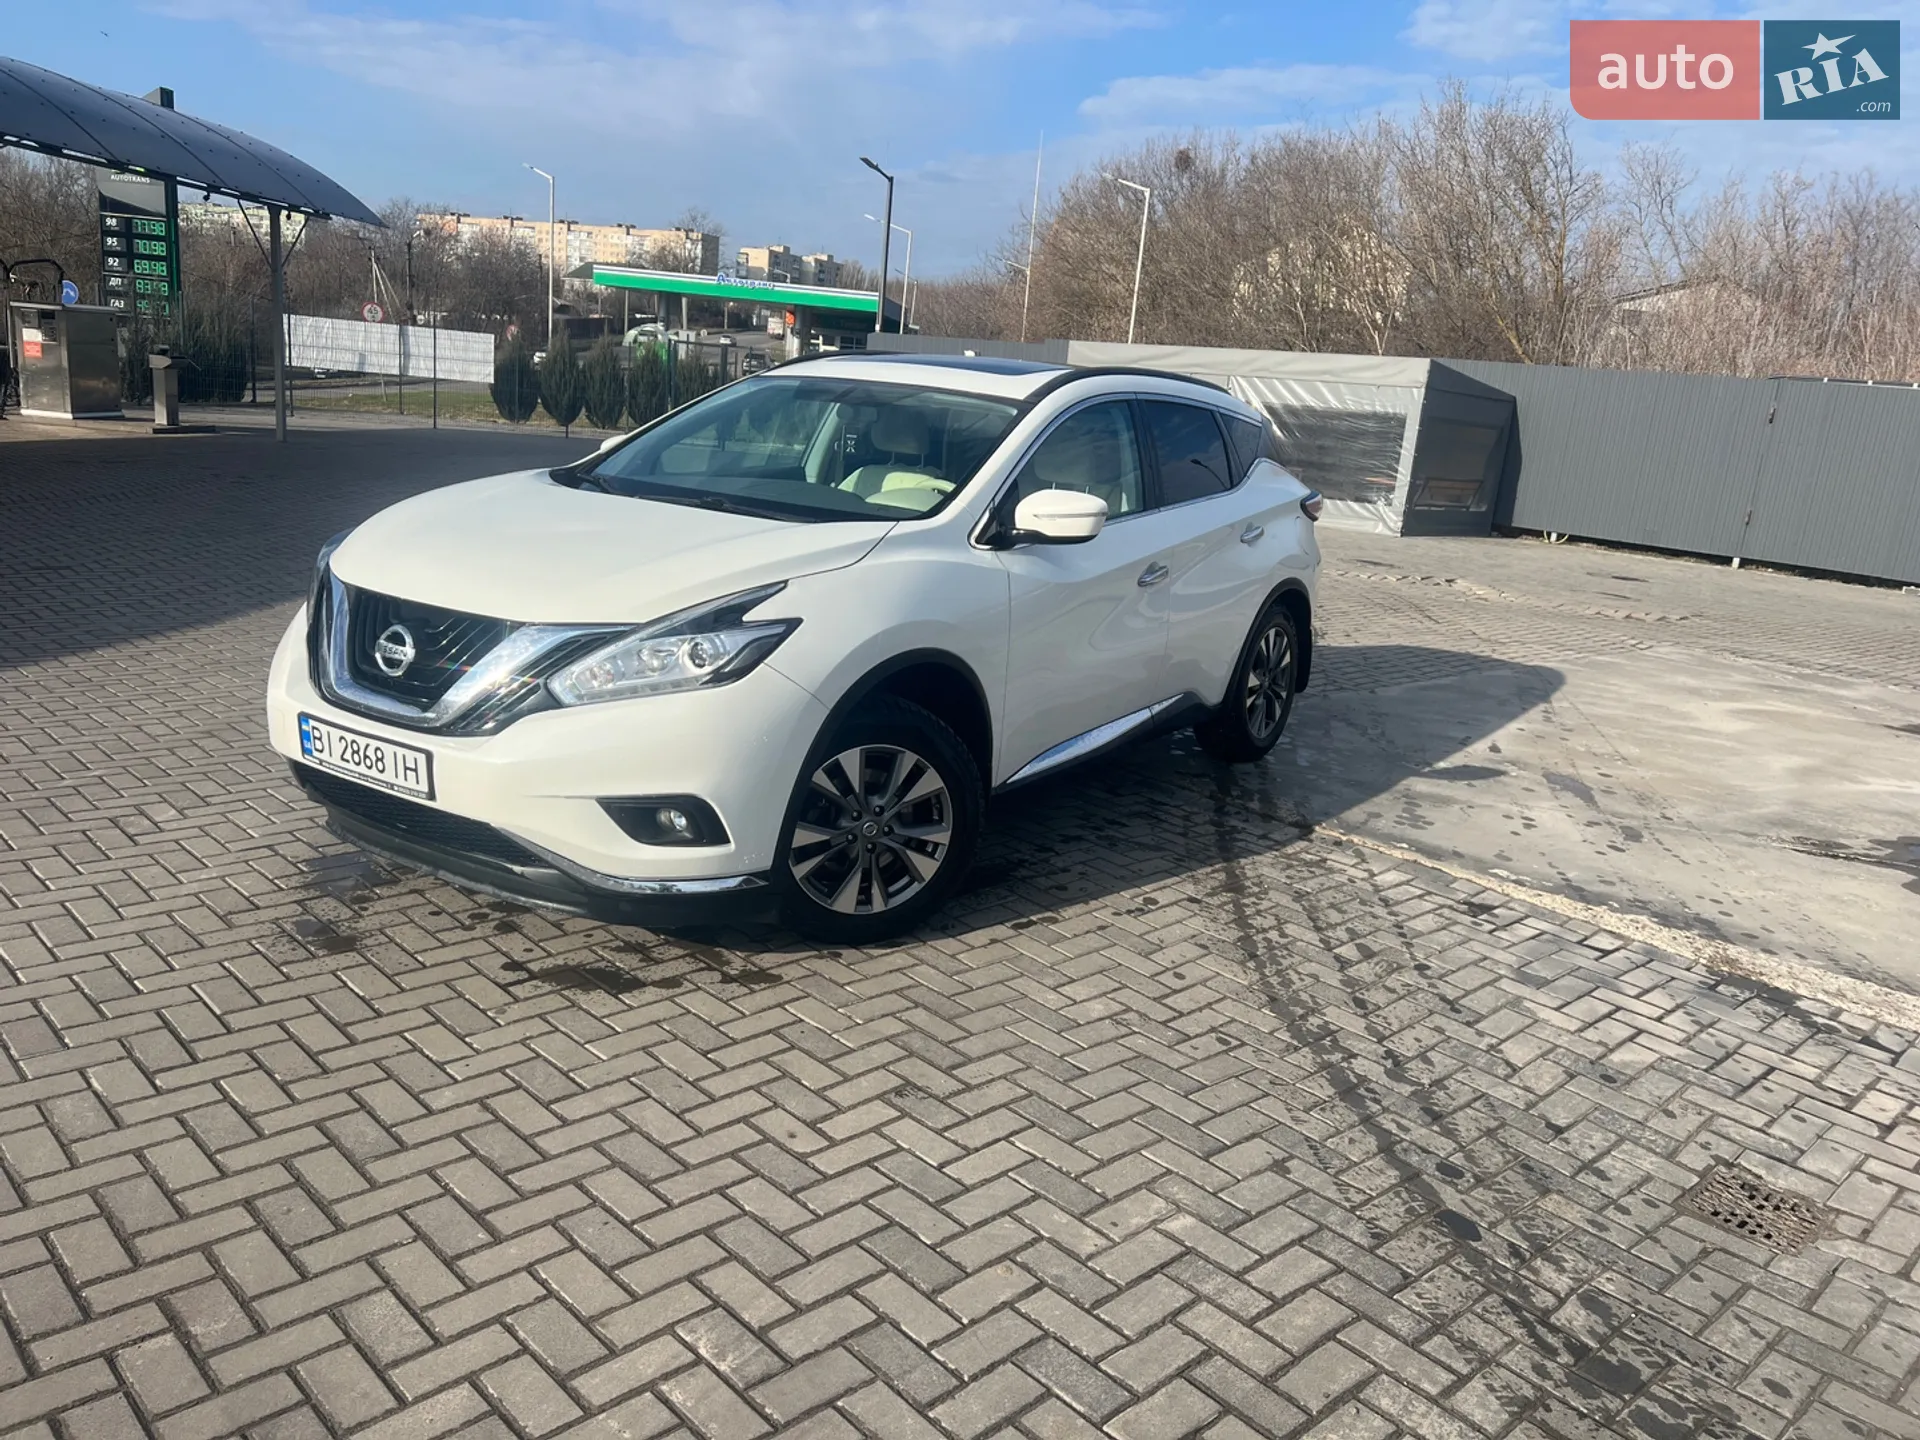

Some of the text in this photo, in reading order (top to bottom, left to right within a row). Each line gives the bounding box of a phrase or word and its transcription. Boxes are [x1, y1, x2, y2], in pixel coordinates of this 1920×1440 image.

[110, 174, 150, 183] AUTOTRANS
[105, 217, 117, 226] 98
[106, 237, 118, 246] 95
[107, 257, 119, 267] 92
[110, 299, 124, 307] ГАЗ
[311, 726, 332, 758] BI
[339, 735, 386, 774] 2868
[394, 751, 419, 785] IH
